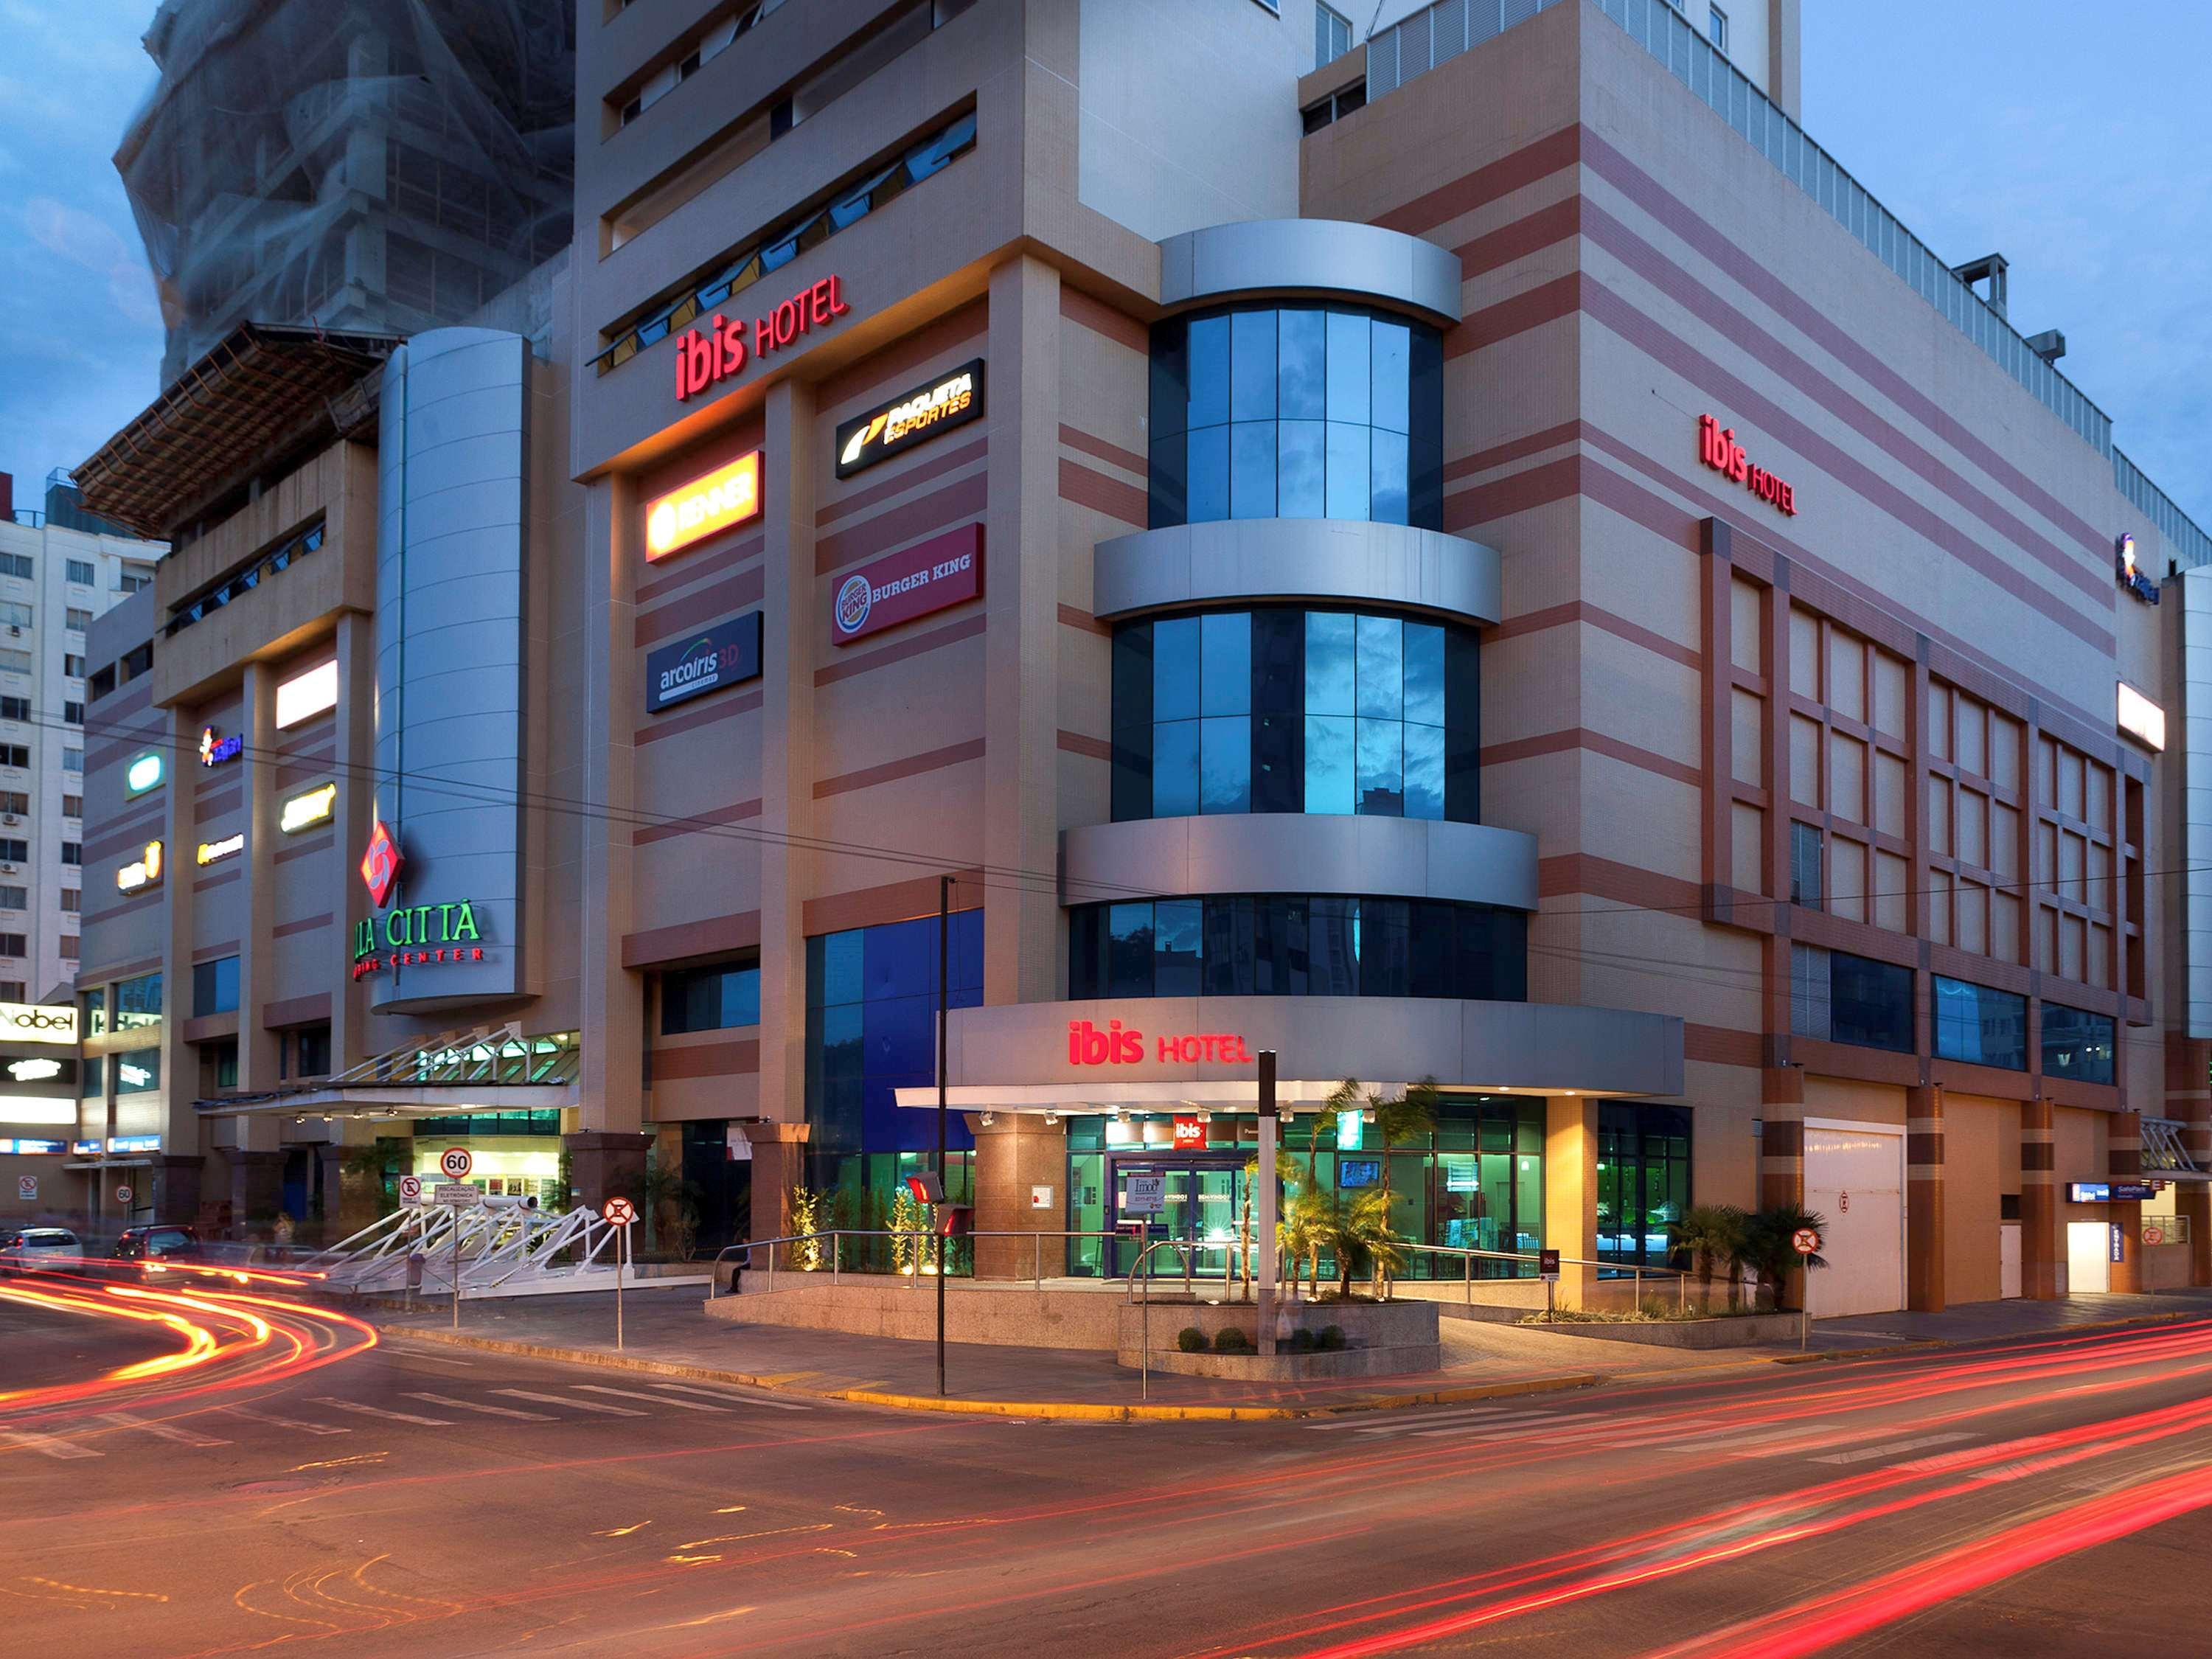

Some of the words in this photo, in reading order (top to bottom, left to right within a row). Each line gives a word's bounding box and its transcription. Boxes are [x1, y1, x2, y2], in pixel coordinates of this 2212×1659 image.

[675, 313, 747, 402] ibis
[754, 273, 849, 358] HOTEL
[883, 390, 972, 445] ESPORTES
[1699, 414, 1747, 483] ibis
[1747, 462, 1798, 517] HOTEL
[872, 570, 929, 603] BURGER
[932, 554, 971, 581] KING
[842, 592, 867, 622] KING
[719, 643, 740, 669] 3D
[390, 947, 484, 967] CENTER
[1068, 1020, 1144, 1065] ibis
[1157, 1034, 1253, 1063] HOTEL
[1175, 1122, 1201, 1138] ibis
[446, 1155, 467, 1170] 60
[118, 1189, 131, 1199] 60
